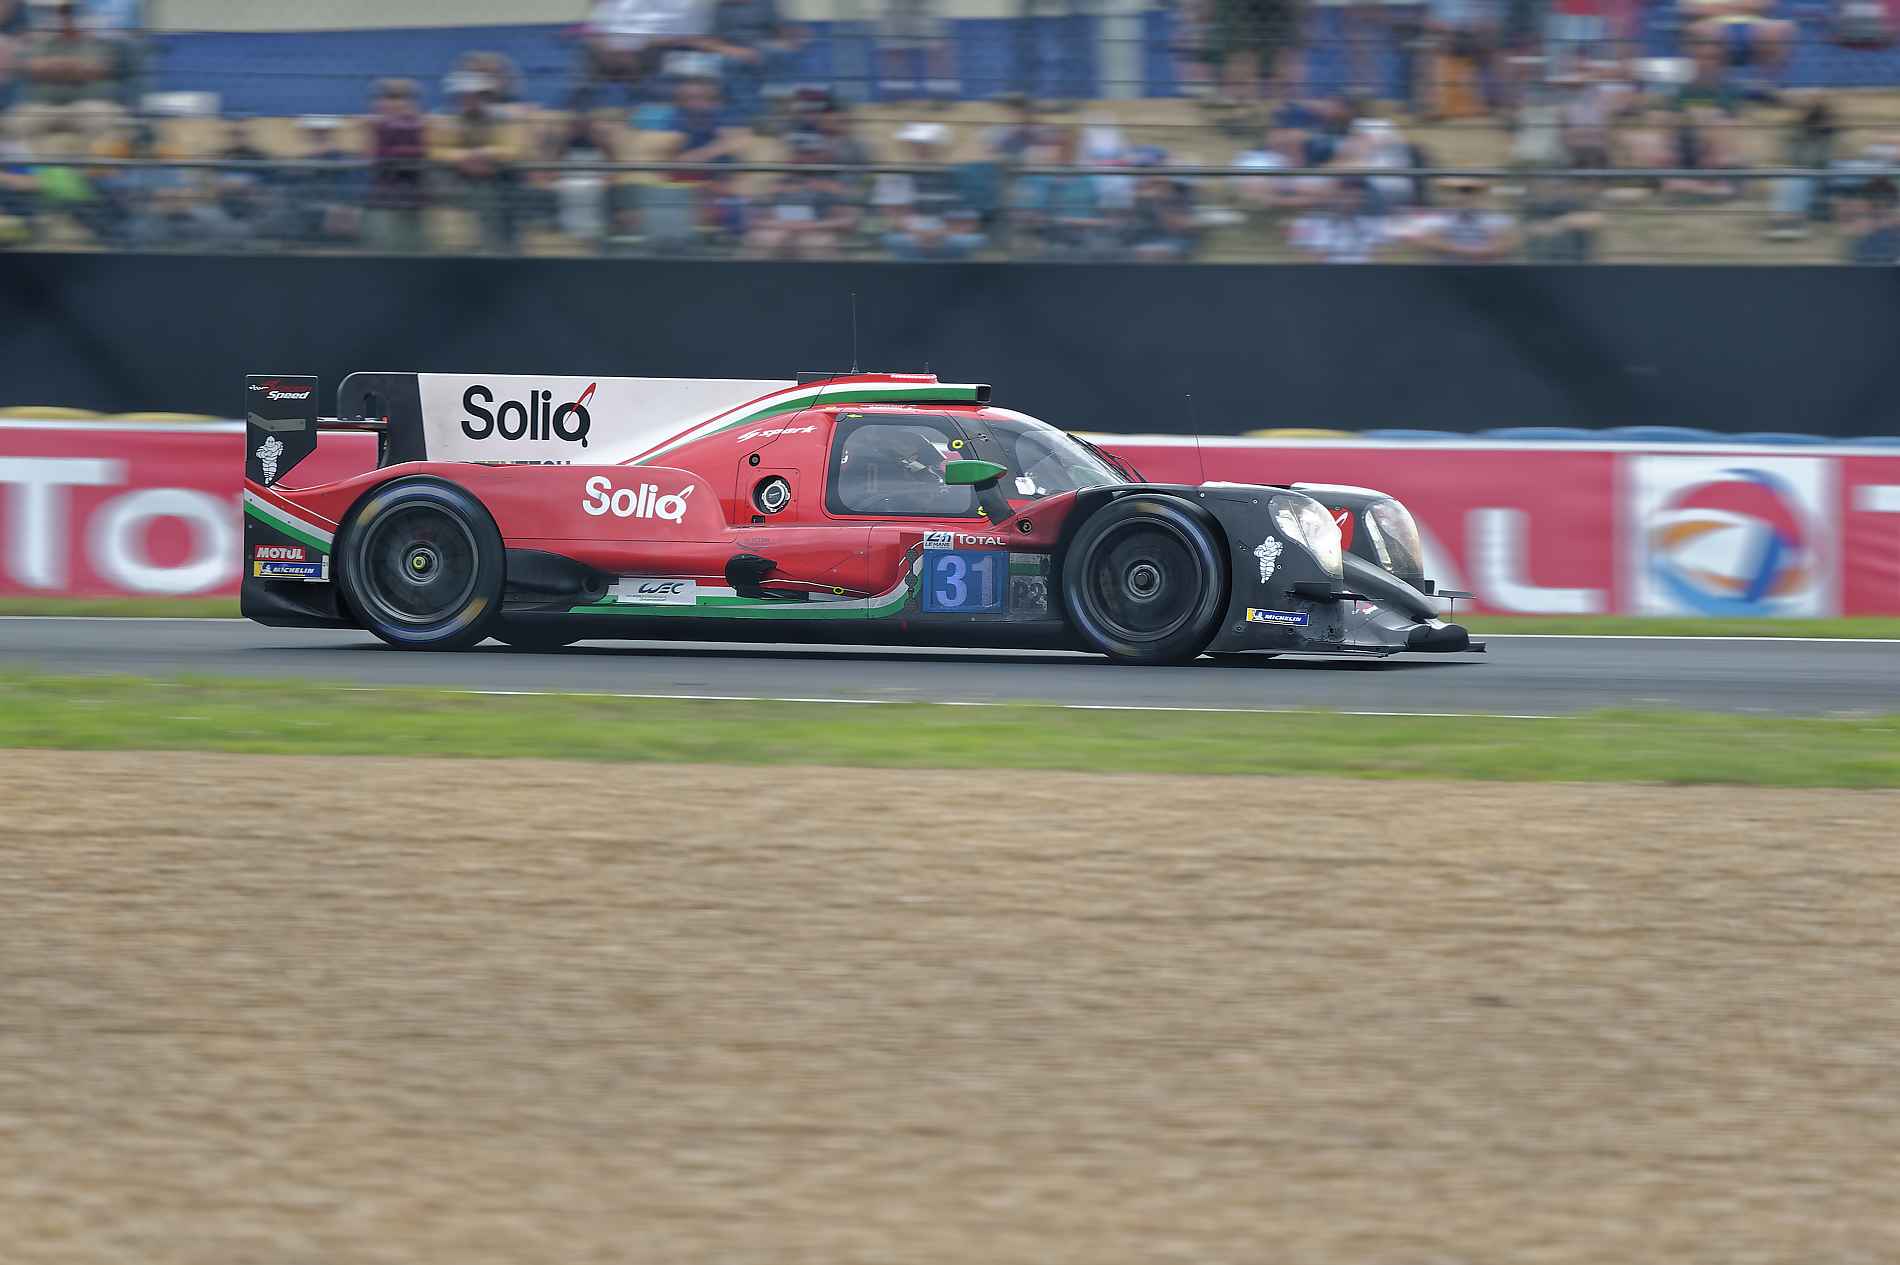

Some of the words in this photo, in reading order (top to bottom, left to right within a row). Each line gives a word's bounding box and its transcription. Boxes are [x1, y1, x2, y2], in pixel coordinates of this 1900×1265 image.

[267, 390, 311, 400] Speed
[256, 547, 304, 560] MOTUL
[936, 555, 993, 608] 31
[639, 582, 685, 594] WEC
[1264, 614, 1302, 622] MICHELIN
